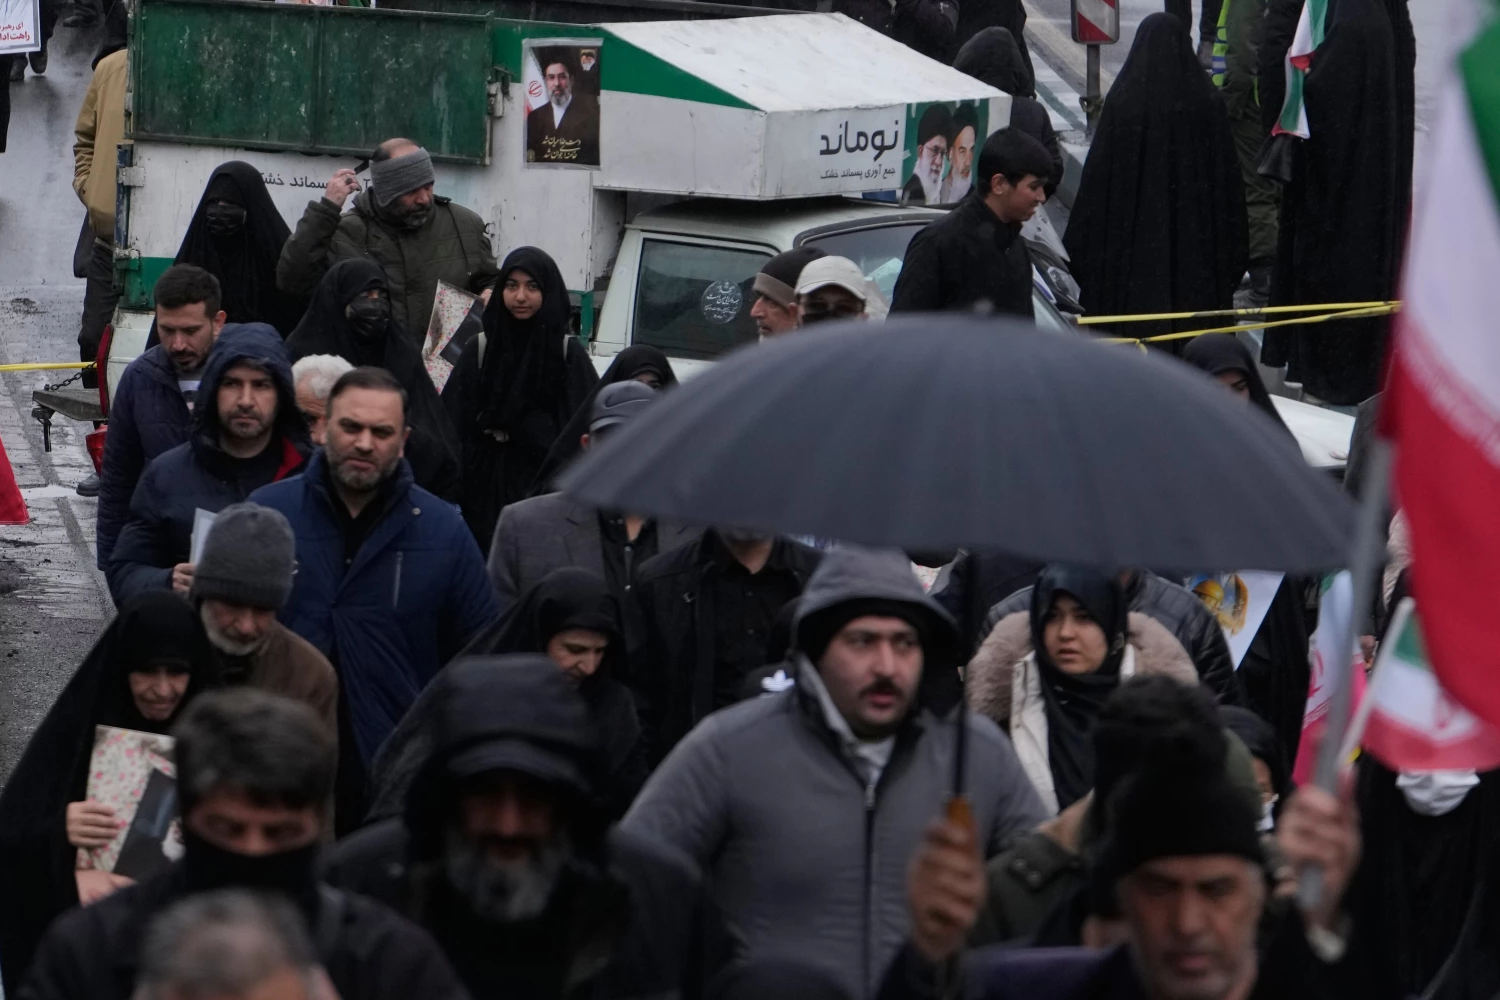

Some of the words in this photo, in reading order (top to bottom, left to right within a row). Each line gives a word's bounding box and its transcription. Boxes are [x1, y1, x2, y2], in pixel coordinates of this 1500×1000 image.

[1, 24, 15, 32] رهبر
[15, 22, 24, 31] ای
[10, 31, 31, 41] راهت
[819, 119, 900, 163] نوماند
[820, 169, 839, 180] خشک
[840, 168, 863, 180] پسماند
[864, 163, 882, 179] آوری
[882, 166, 896, 180] جمع
[289, 176, 329, 189] سماند
